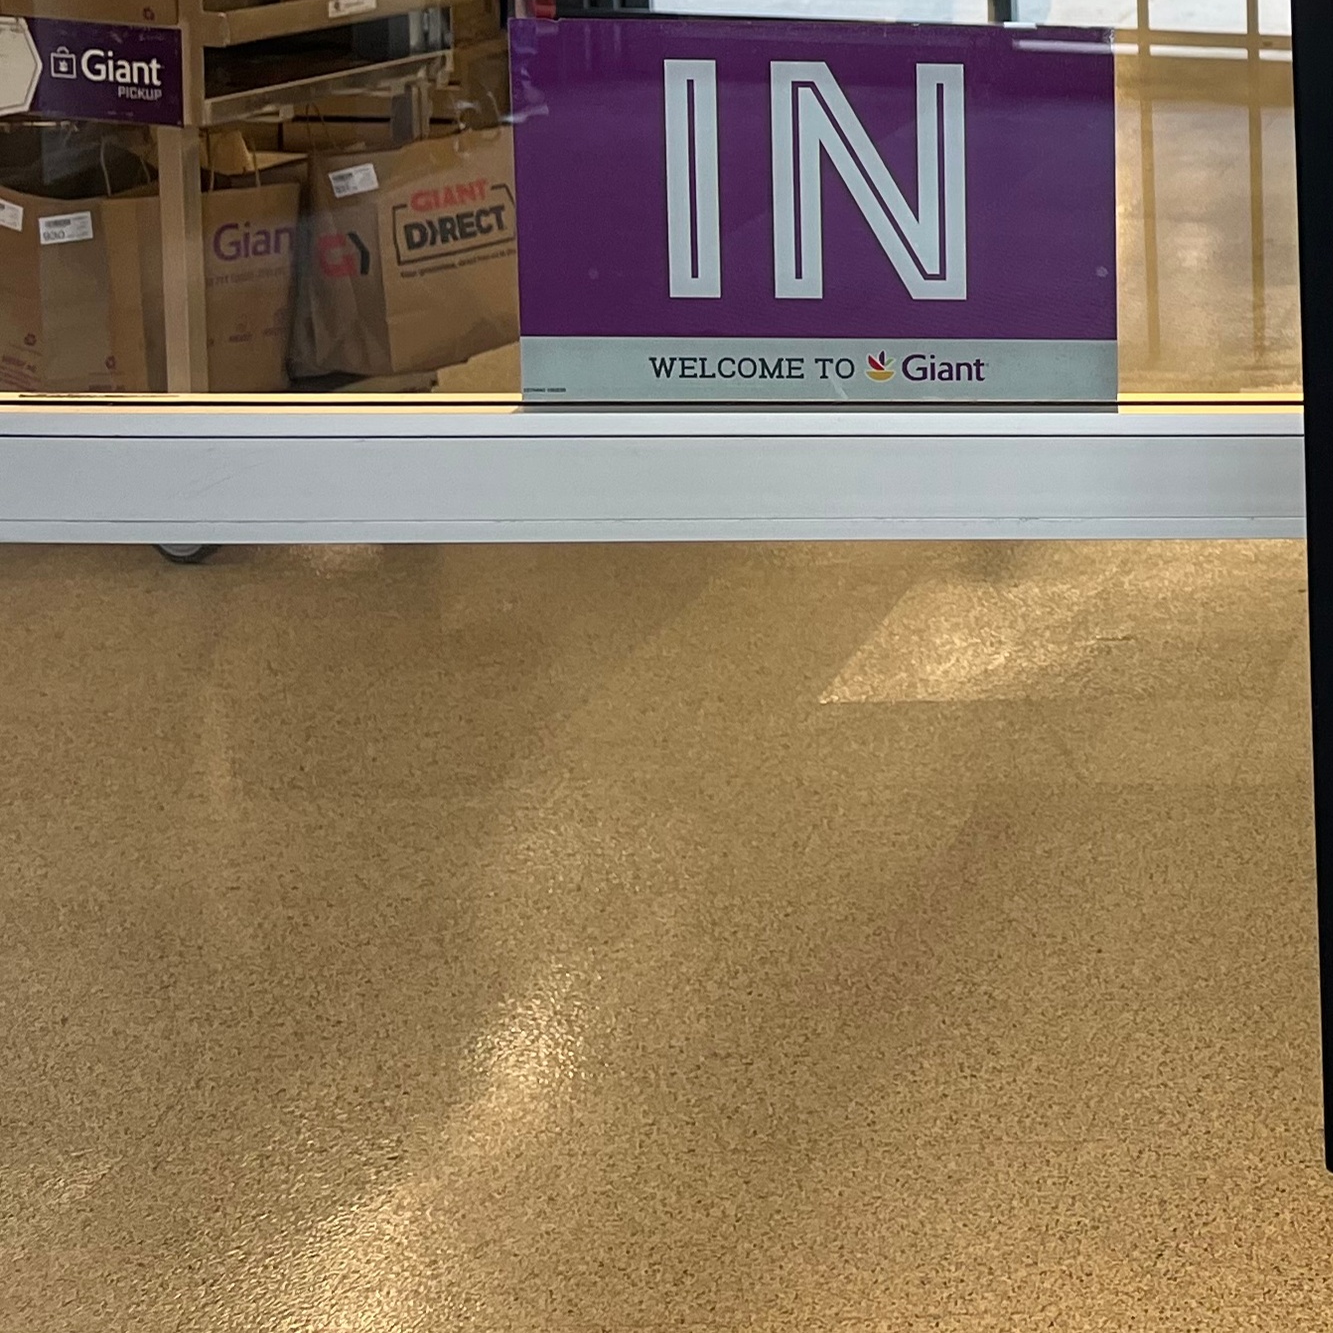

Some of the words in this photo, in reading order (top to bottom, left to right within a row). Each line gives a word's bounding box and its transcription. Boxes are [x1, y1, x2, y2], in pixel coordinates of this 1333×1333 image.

[81, 49, 162, 86] Giant
[118, 86, 162, 100] PICKUP
[410, 179, 487, 211] GIANT
[664, 58, 966, 300] IN
[649, 356, 804, 380] WELCOME
[816, 357, 855, 380] TO
[901, 353, 985, 382] Giant
